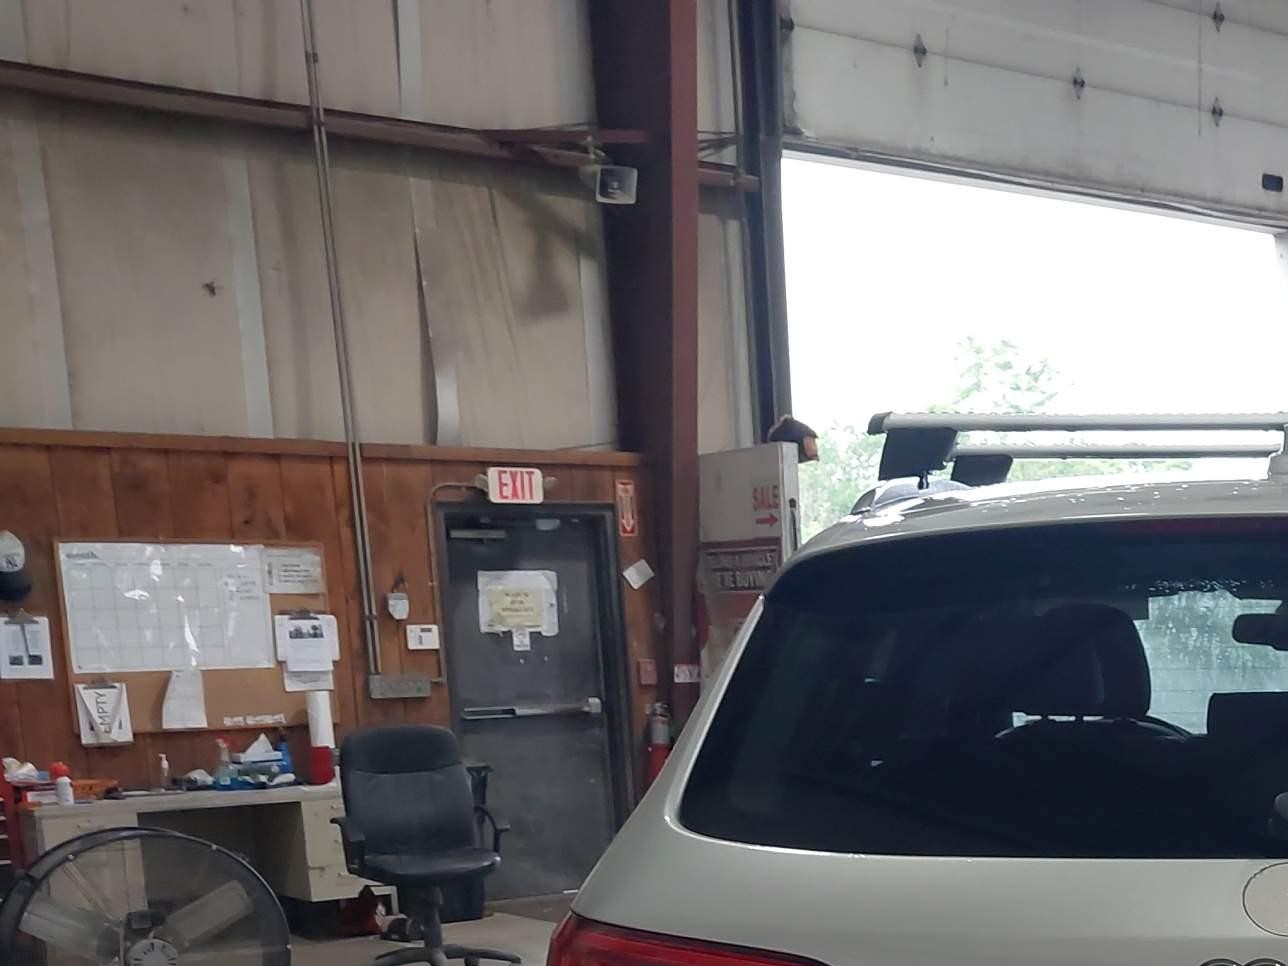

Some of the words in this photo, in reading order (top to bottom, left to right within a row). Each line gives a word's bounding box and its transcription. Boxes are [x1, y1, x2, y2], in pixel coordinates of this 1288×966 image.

[497, 469, 536, 500] EXIT
[752, 485, 779, 512] SALE
[94, 691, 113, 734] EMPTY
